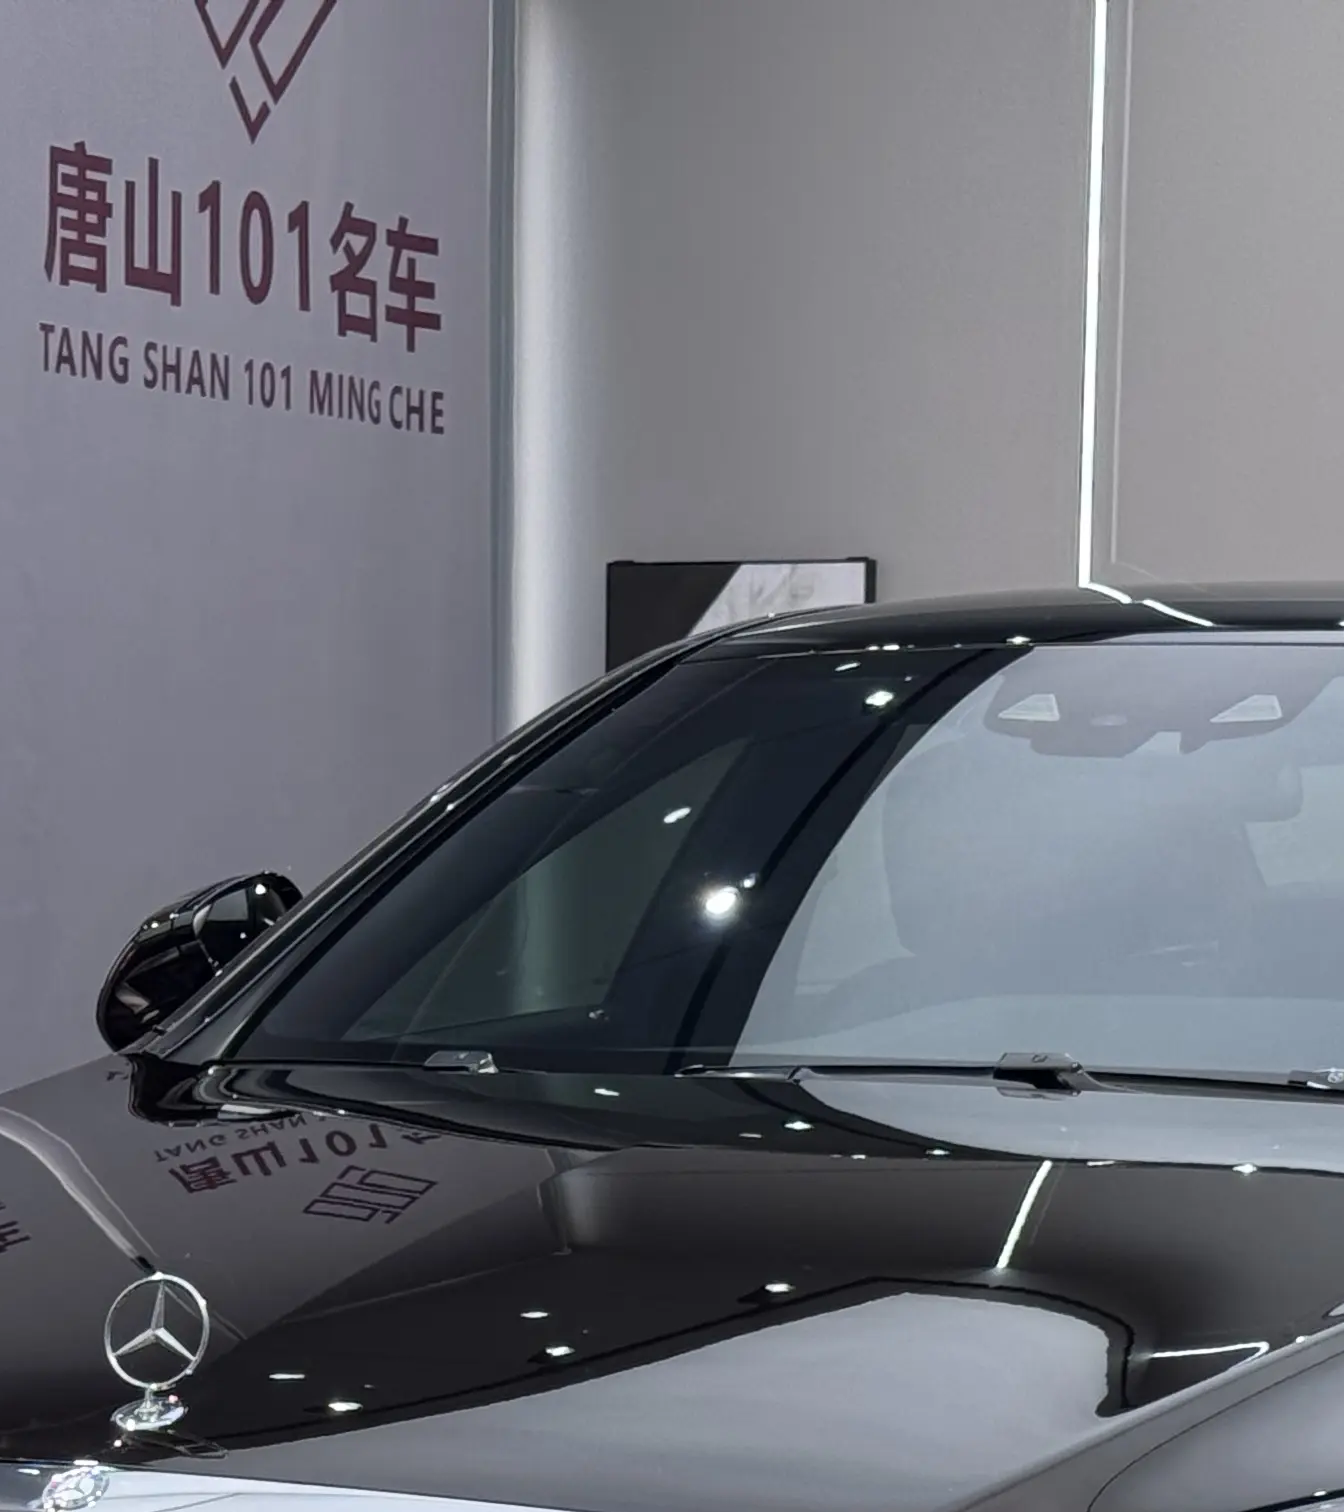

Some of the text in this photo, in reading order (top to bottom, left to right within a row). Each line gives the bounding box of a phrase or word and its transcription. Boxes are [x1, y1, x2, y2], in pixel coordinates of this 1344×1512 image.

[43, 140, 442, 354] 唐山101名车
[39, 322, 445, 436] TANG SHAN 101 MING CHE
